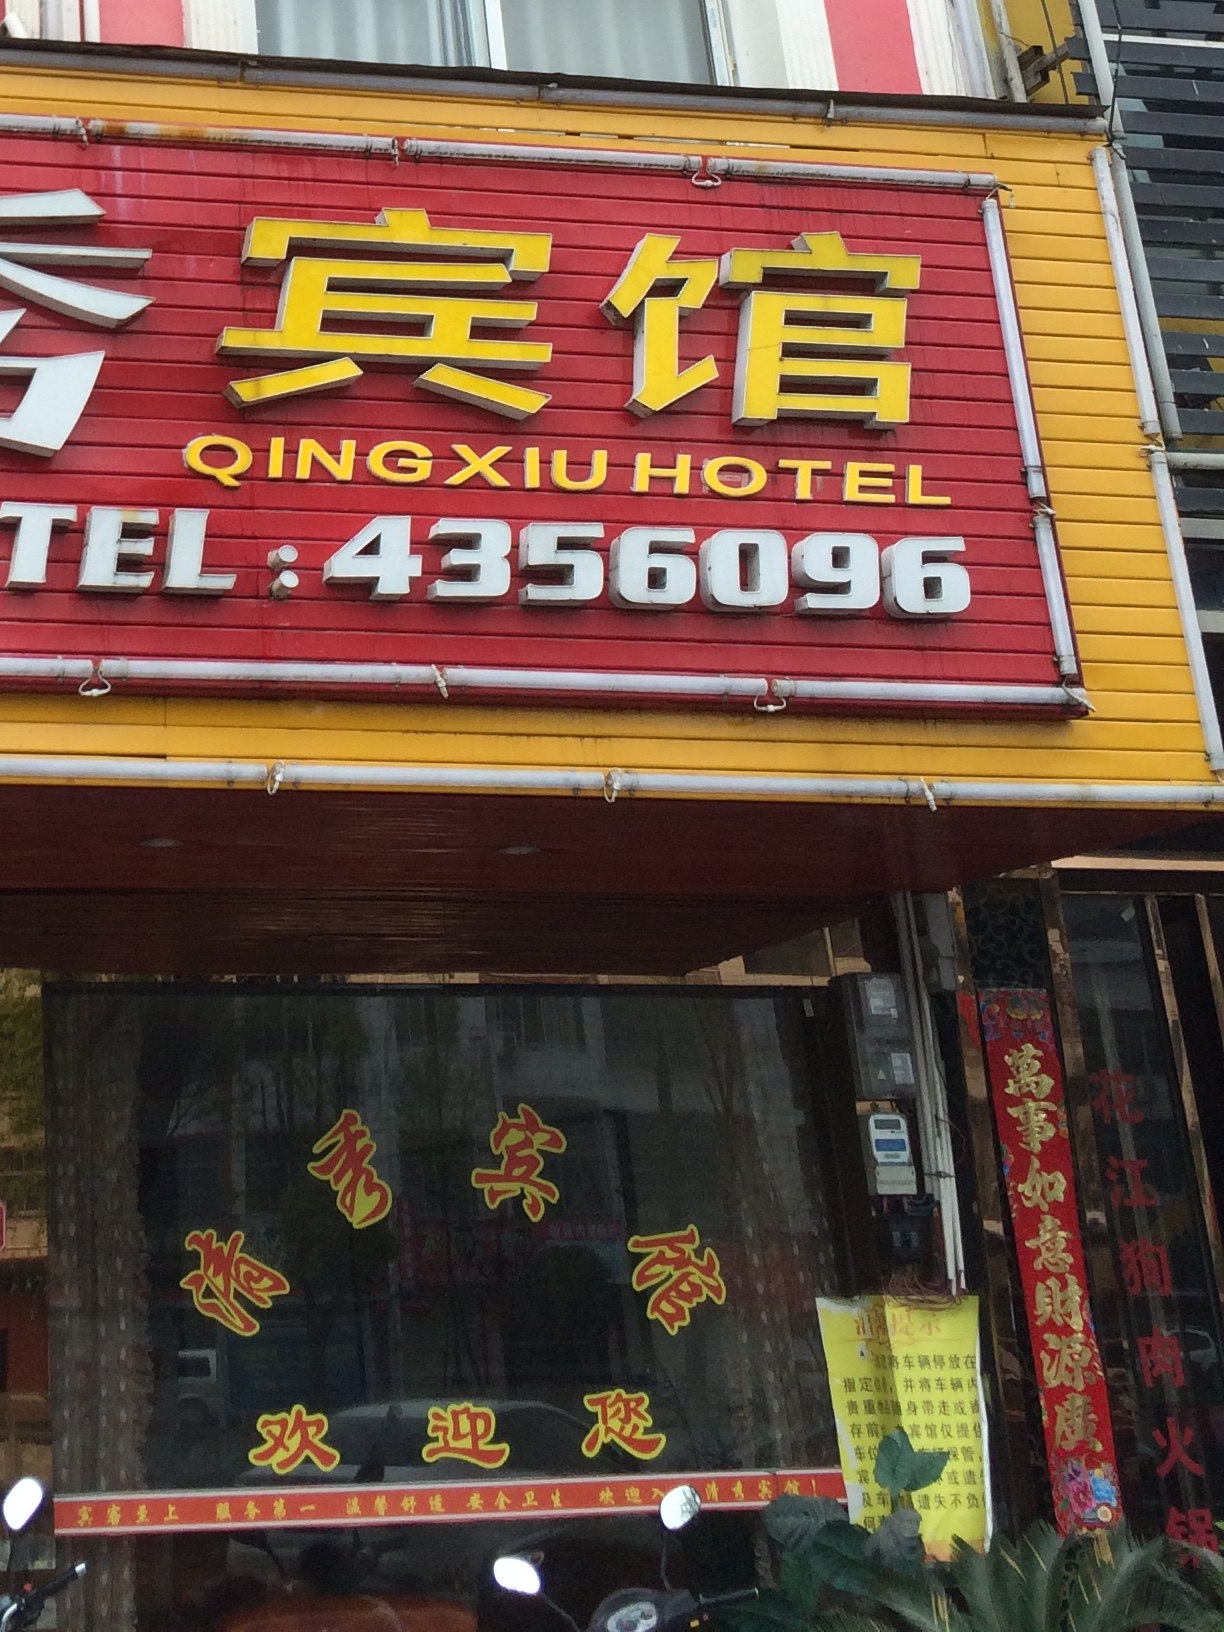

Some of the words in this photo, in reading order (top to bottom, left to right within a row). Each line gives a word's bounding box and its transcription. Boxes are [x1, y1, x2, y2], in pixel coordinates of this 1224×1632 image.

[183, 431, 609, 492] QINGXIU
[631, 451, 952, 506] HOTEL
[853, 1308, 942, 1340] 提示
[249, 1388, 666, 1474] 欢迎您
[215, 1497, 314, 1521] 服务第一
[465, 1488, 562, 1511] 安全卫生
